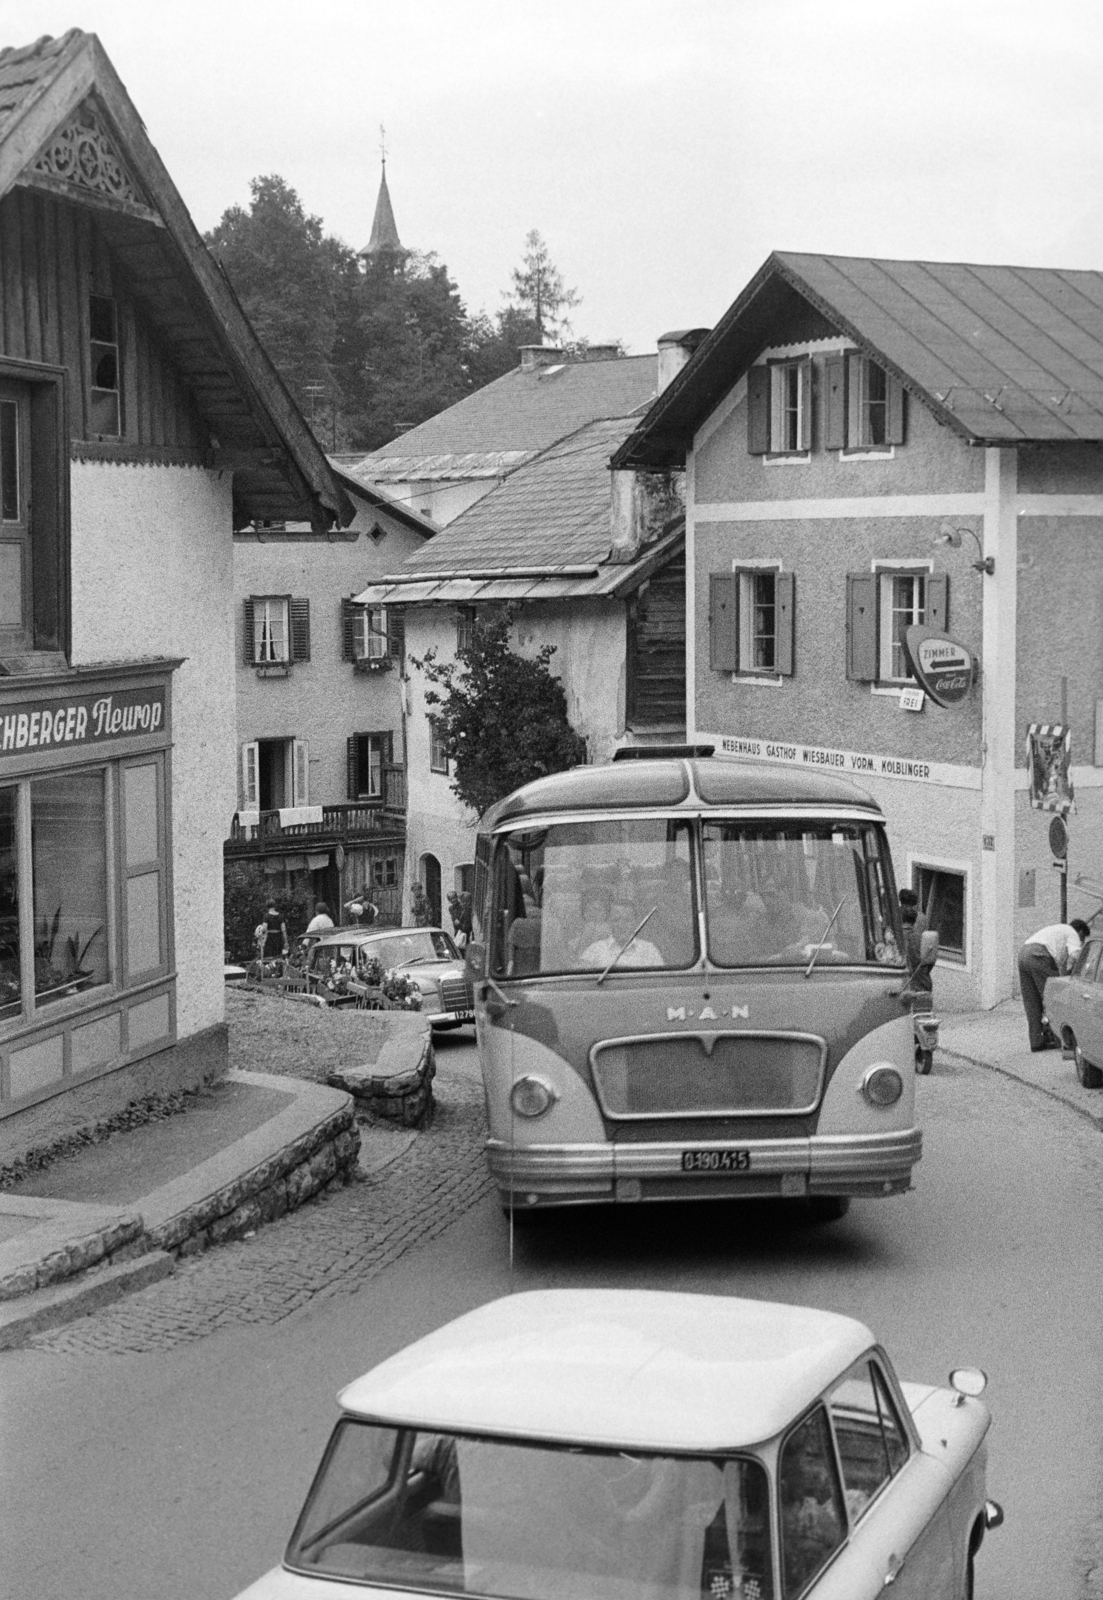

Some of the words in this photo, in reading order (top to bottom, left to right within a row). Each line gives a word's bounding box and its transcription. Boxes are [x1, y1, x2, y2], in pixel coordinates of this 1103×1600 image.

[923, 647, 956, 660] ZIMMER
[92, 695, 162, 736] Fleurop
[722, 738, 761, 756] NEBENHAUS
[766, 745, 797, 760] GASTHOF
